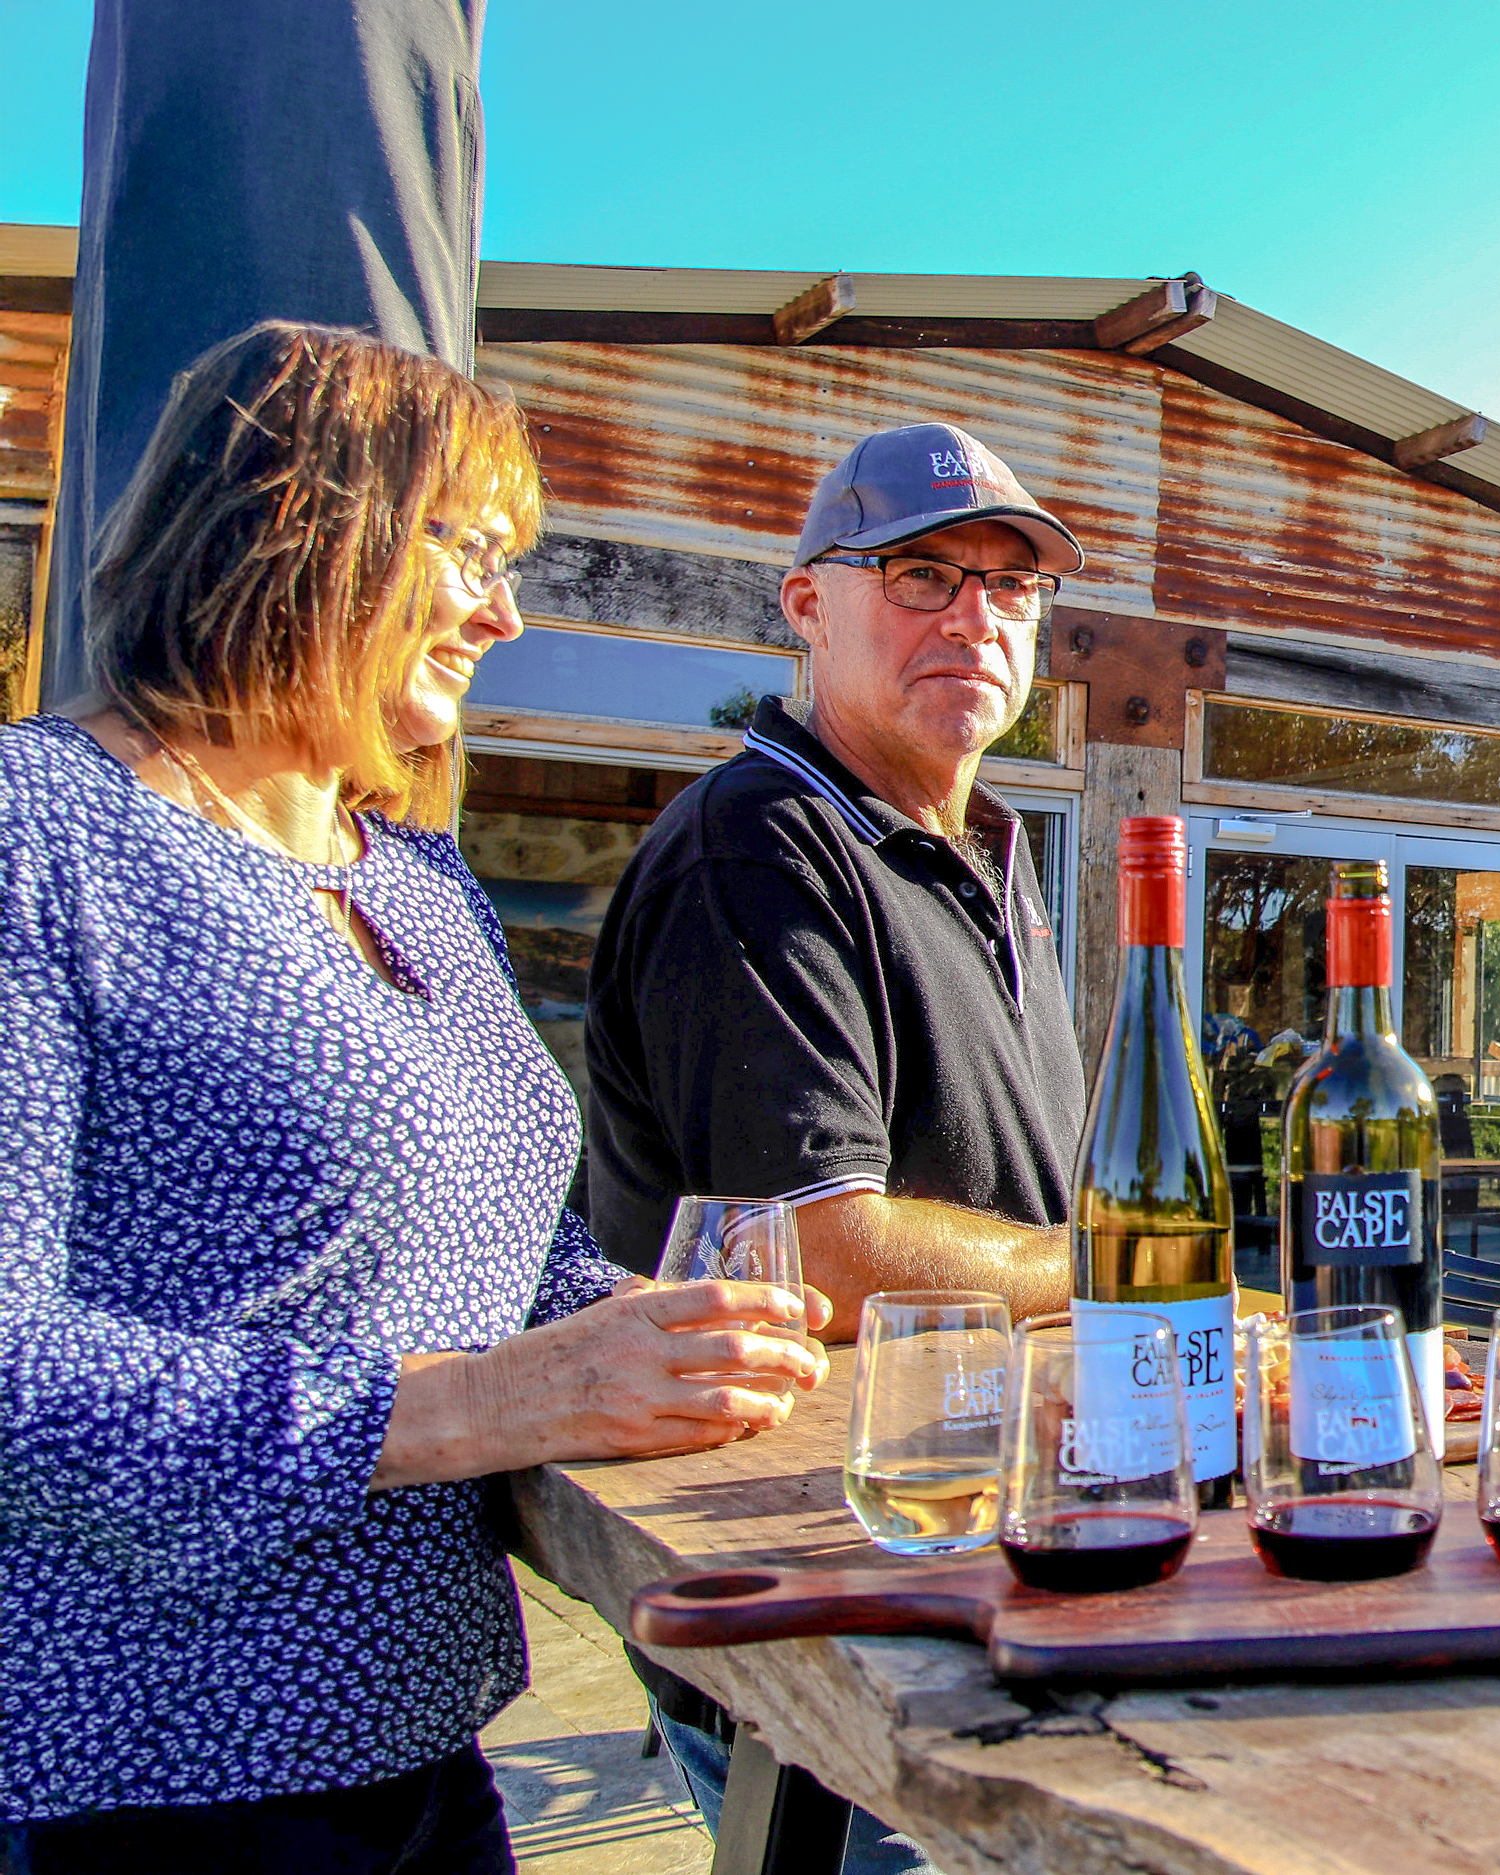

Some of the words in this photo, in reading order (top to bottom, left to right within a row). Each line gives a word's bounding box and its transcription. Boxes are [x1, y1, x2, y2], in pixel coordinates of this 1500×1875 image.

[1315, 1189, 1410, 1225] FALSE
[1315, 1212, 1411, 1248] CAPE
[1132, 1327, 1223, 1361] FALSE
[1131, 1350, 1224, 1387] CAPE
[1060, 1418, 1147, 1450] FALSE
[1317, 1425, 1400, 1459] CAPE
[1059, 1440, 1148, 1472] CAPE
